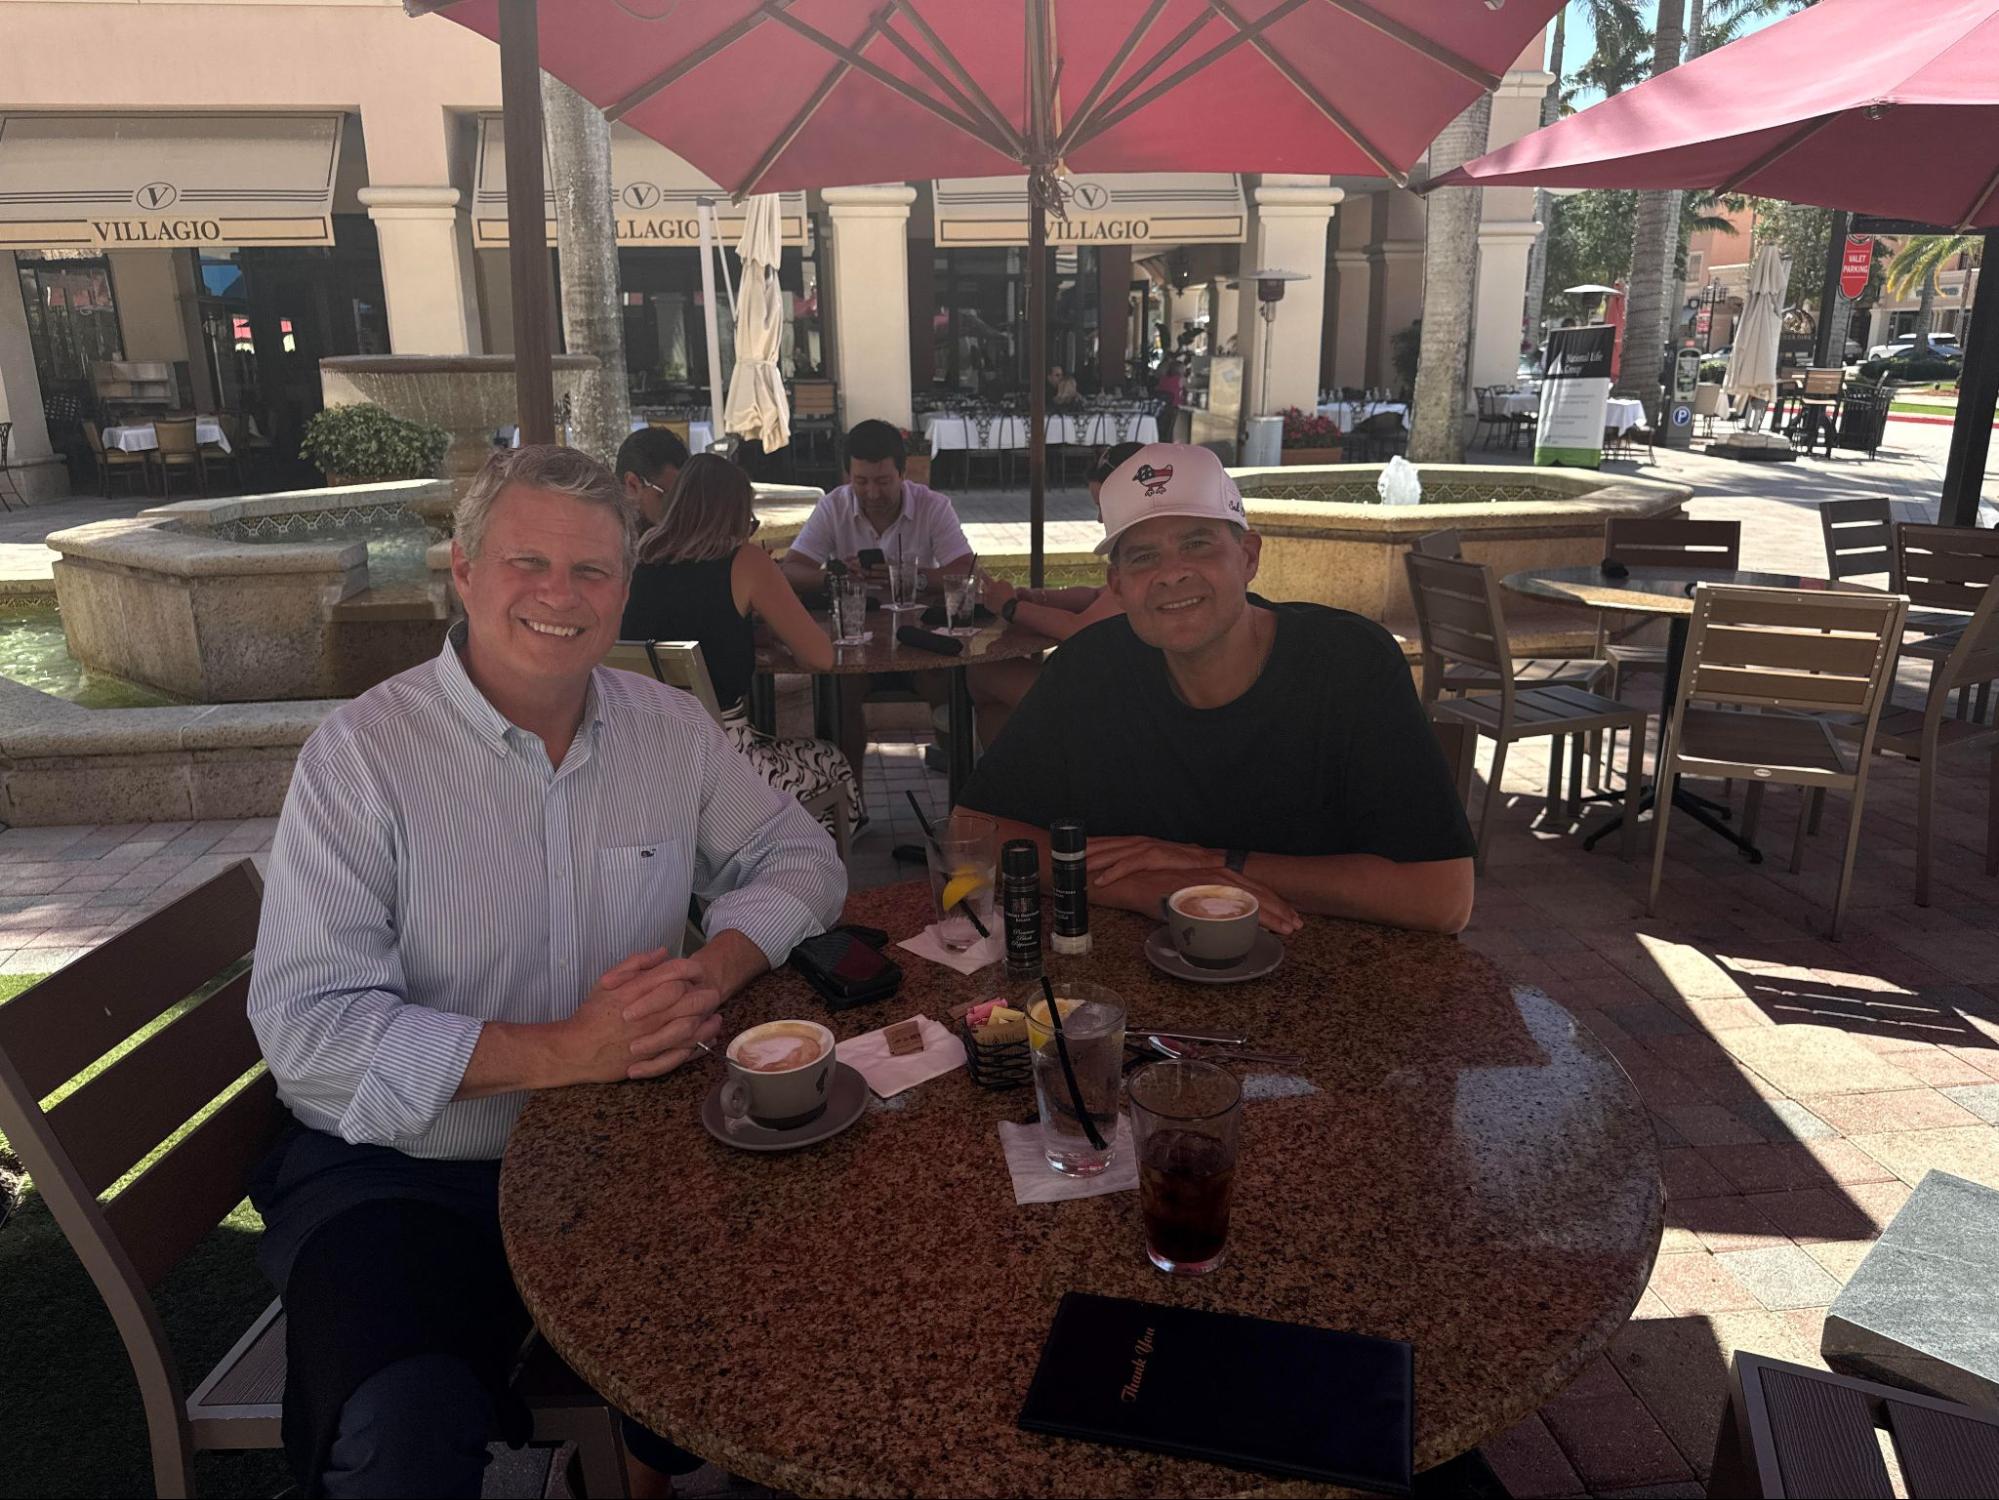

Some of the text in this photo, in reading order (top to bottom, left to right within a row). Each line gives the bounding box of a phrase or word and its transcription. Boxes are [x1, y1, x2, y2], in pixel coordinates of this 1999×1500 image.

[147, 187, 170, 207] V
[631, 187, 652, 206] V
[1080, 188, 1099, 208] V
[92, 220, 220, 242] VILLAGIO
[614, 219, 701, 240] LLAGIO
[1848, 254, 1867, 263] VALET
[1843, 264, 1869, 274] PARKING
[1677, 409, 1688, 423] P
[1119, 1326, 1157, 1404] Thank You
